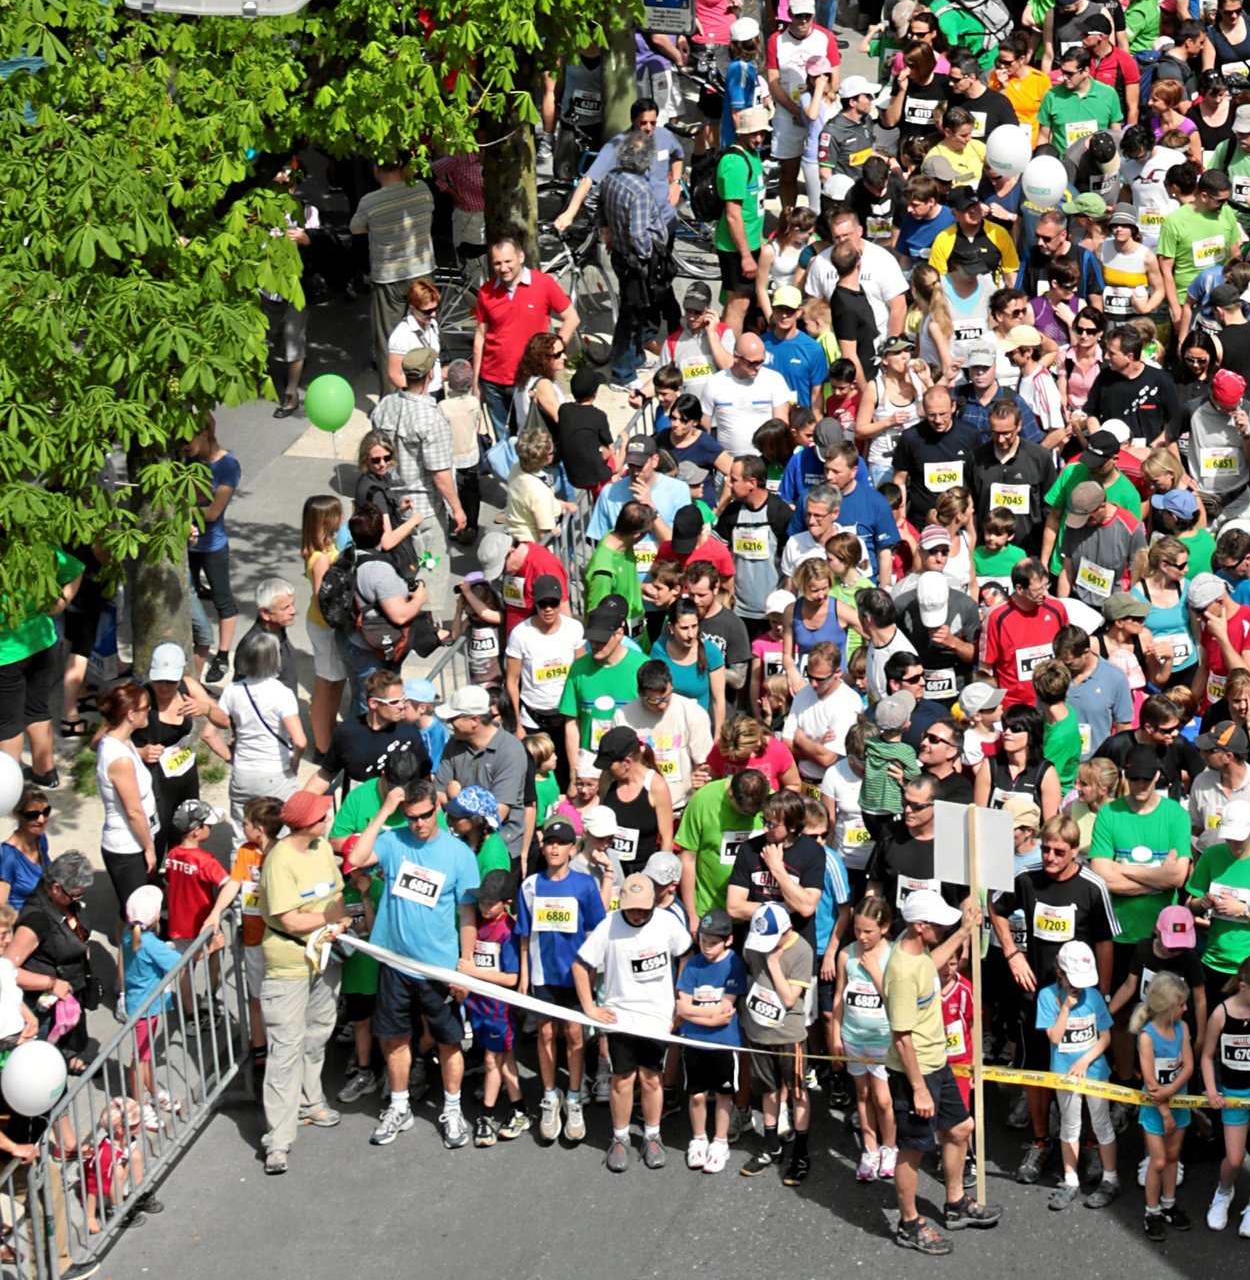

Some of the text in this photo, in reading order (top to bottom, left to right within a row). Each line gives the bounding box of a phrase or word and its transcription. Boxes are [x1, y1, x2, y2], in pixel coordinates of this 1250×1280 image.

[691, 366, 710, 378] 6563
[1213, 459, 1233, 470] 6851
[936, 472, 957, 483] 6290
[1002, 495, 1023, 506] 7045
[743, 541, 763, 551] 6216
[1086, 574, 1106, 588] 6812
[546, 667, 568, 679] 6194
[925, 679, 949, 692] 6877
[408, 875, 434, 897] 6881
[546, 910, 571, 922] 6880
[1043, 918, 1066, 932] 7203
[475, 954, 493, 967] 882
[641, 952, 667, 971] 6594
[855, 995, 881, 1009] 6887
[754, 1002, 778, 1019] 6595
[1070, 1027, 1094, 1044] 6625
